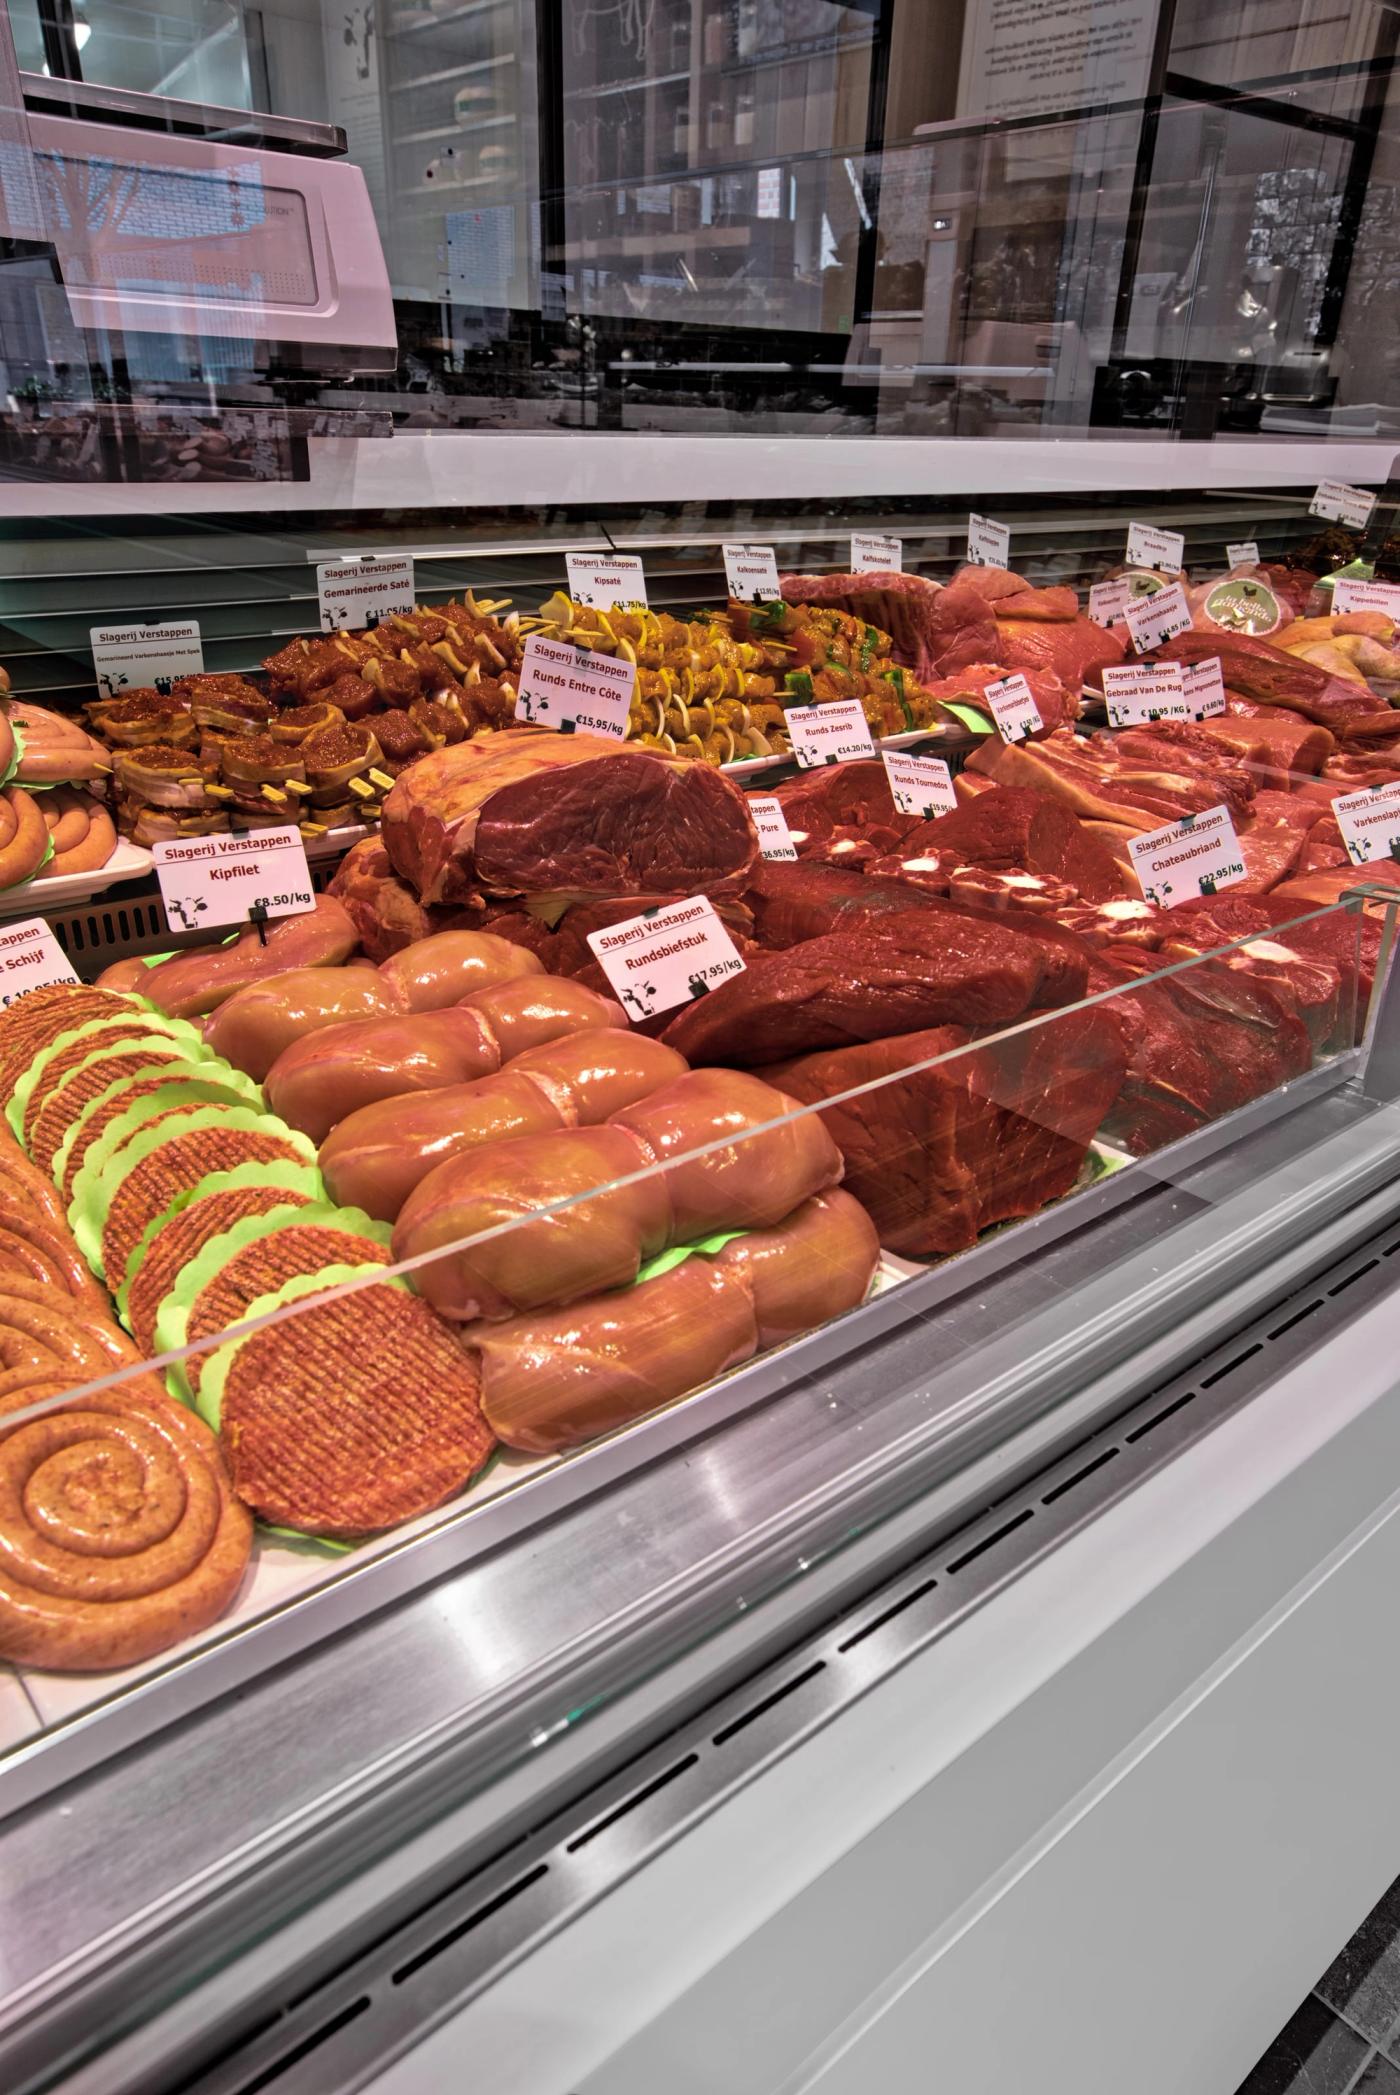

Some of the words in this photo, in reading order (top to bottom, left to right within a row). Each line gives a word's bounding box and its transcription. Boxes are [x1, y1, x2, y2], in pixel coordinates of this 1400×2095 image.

[855, 537, 873, 548] Slagerij
[873, 541, 899, 550] Verstappen
[727, 549, 746, 559] Slagerij
[746, 551, 772, 559] Verstappen
[324, 566, 358, 579] Slagerij
[359, 561, 407, 575] Verstappen
[572, 558, 599, 568] Slagerij
[599, 559, 638, 569] Verstappen
[736, 565, 768, 574] Kalkoensaté
[323, 582, 389, 599] Gemarineerde
[390, 578, 410, 590] Saté
[594, 576, 622, 586] Kipsaté
[1339, 582, 1365, 592] Slagerij
[1127, 602, 1149, 615] Slagerij
[1148, 588, 1179, 606] Verstappen
[1349, 595, 1389, 606] Kippebillen
[365, 610, 372, 619] €
[1136, 603, 1178, 627] Varkenshaasje
[100, 630, 138, 643] Slagerij
[139, 627, 193, 640] Verstappen
[96, 654, 134, 663] Gemarineerd
[135, 650, 175, 660] Varkenshaasje
[187, 648, 201, 656] Spek
[534, 643, 573, 665] Slagerij
[575, 654, 628, 679] Verstappen
[1107, 670, 1135, 681] Slagerij
[1136, 667, 1176, 678] Verstappen
[1193, 663, 1218, 677] Verstappen
[532, 669, 566, 687] Runds
[568, 679, 597, 695] Entre
[598, 687, 622, 702] Côte
[1106, 686, 1138, 698] Gebraad
[1139, 685, 1155, 695] Van
[1155, 684, 1167, 693] De
[1167, 683, 1183, 693] Rug
[790, 710, 818, 722] Slagerij
[818, 705, 857, 717] Verstappen
[1140, 709, 1147, 717] €
[576, 714, 624, 736] €15,95/kg
[805, 726, 829, 737] Runds
[830, 722, 853, 734] Zesrib
[837, 743, 873, 755] €14.20/kg
[888, 756, 912, 769] Slagerij
[912, 760, 945, 772] Verstappen
[893, 773, 915, 786] Runds
[914, 777, 949, 790] Tournedos
[1338, 796, 1369, 812] Slagerij
[760, 824, 780, 833] Pure
[1135, 834, 1172, 854] Slagerij
[1171, 815, 1224, 839] Verstappen
[165, 843, 216, 860] Slagerij
[218, 834, 292, 853] Verstappen
[1151, 836, 1222, 873] Chateaubriand
[209, 863, 261, 881] Kipfilet
[1198, 863, 1245, 885] €22.95/kg
[254, 891, 311, 909] €8.50/kg
[599, 925, 646, 950] Slagerij
[643, 905, 705, 933] Verstappen
[625, 931, 709, 971] Rundsbiefstuk
[5, 949, 46, 971] Schijf
[687, 957, 743, 985] €17.95/kg
